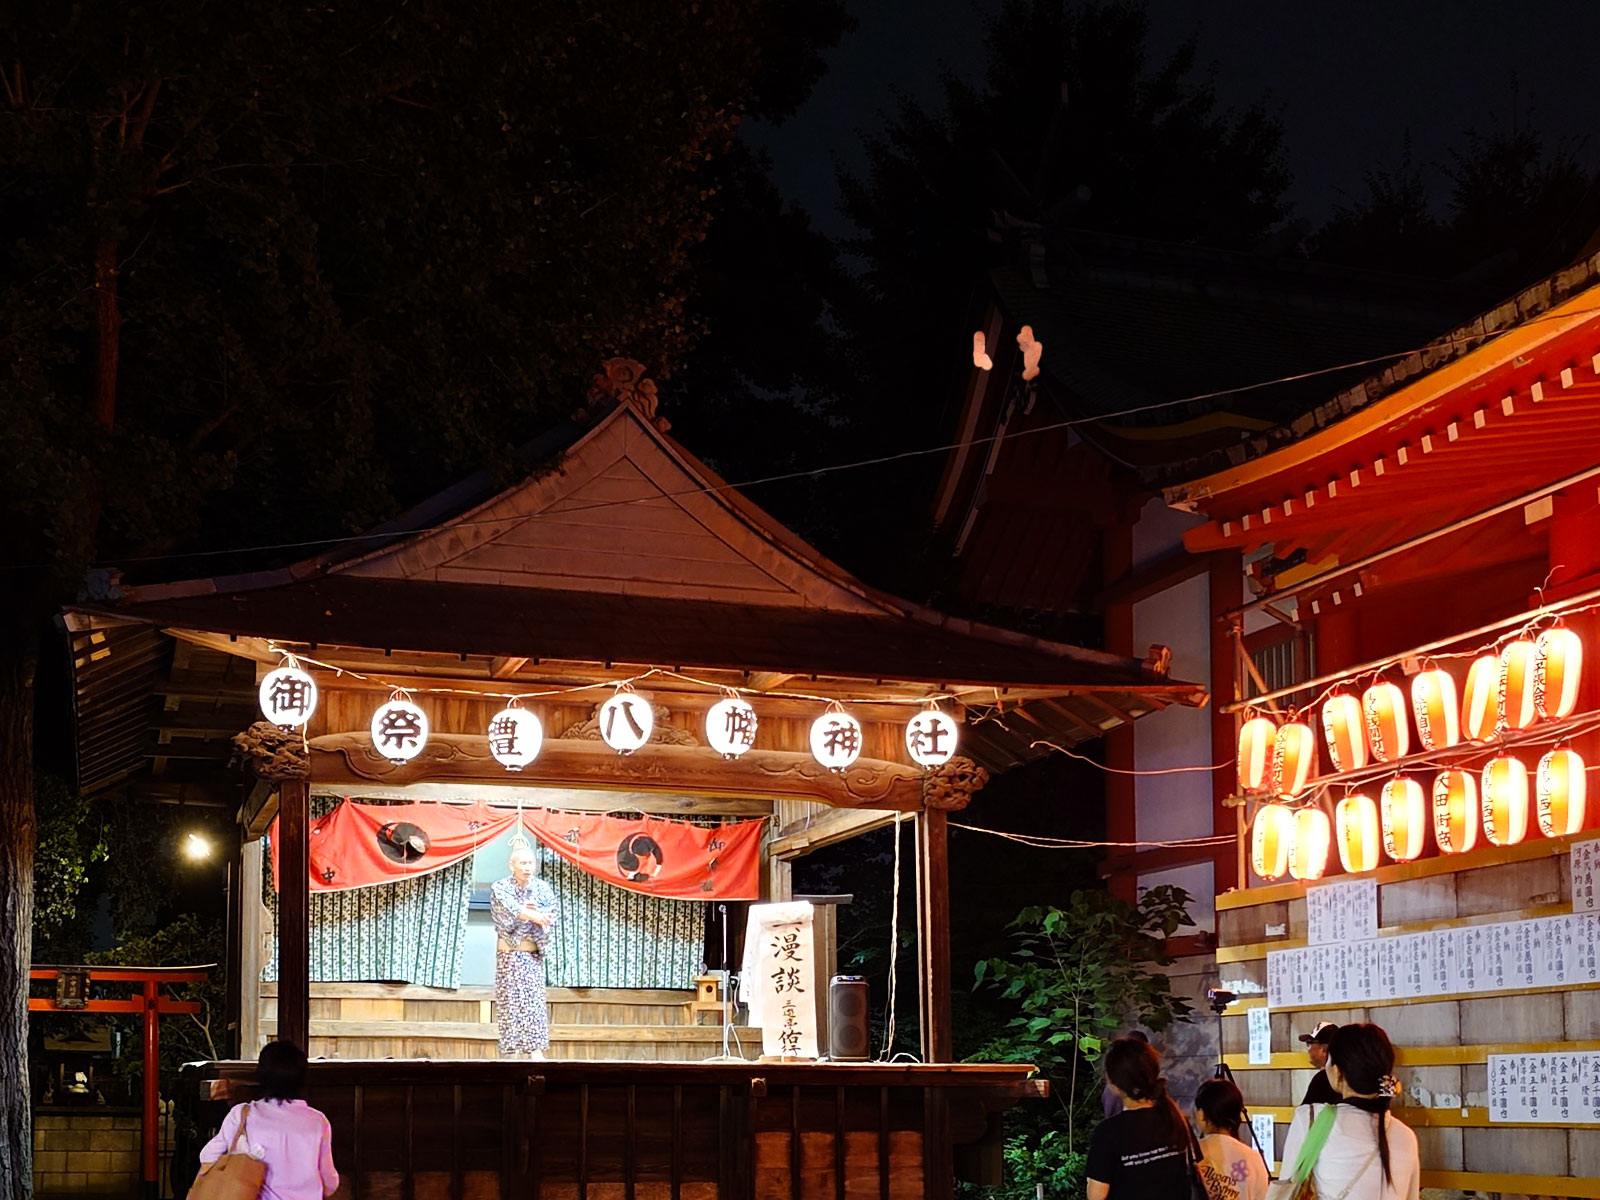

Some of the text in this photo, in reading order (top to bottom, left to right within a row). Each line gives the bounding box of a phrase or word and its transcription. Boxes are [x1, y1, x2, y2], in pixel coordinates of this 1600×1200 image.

[269, 675, 312, 717] 御
[378, 708, 421, 749] 祭
[605, 700, 644, 741] 八
[823, 721, 860, 758] 神
[911, 718, 948, 757] 社
[1499, 1060, 1507, 1119] 一金五千圓也
[1509, 1059, 1516, 1085] 奉納
[1529, 1057, 1538, 1118] 一金五千圓也
[1540, 1057, 1547, 1083] 奉納
[1560, 1056, 1569, 1118] 一金五千圓也
[1571, 1056, 1579, 1083] 奉納
[1200, 1165, 1237, 1187] Always
